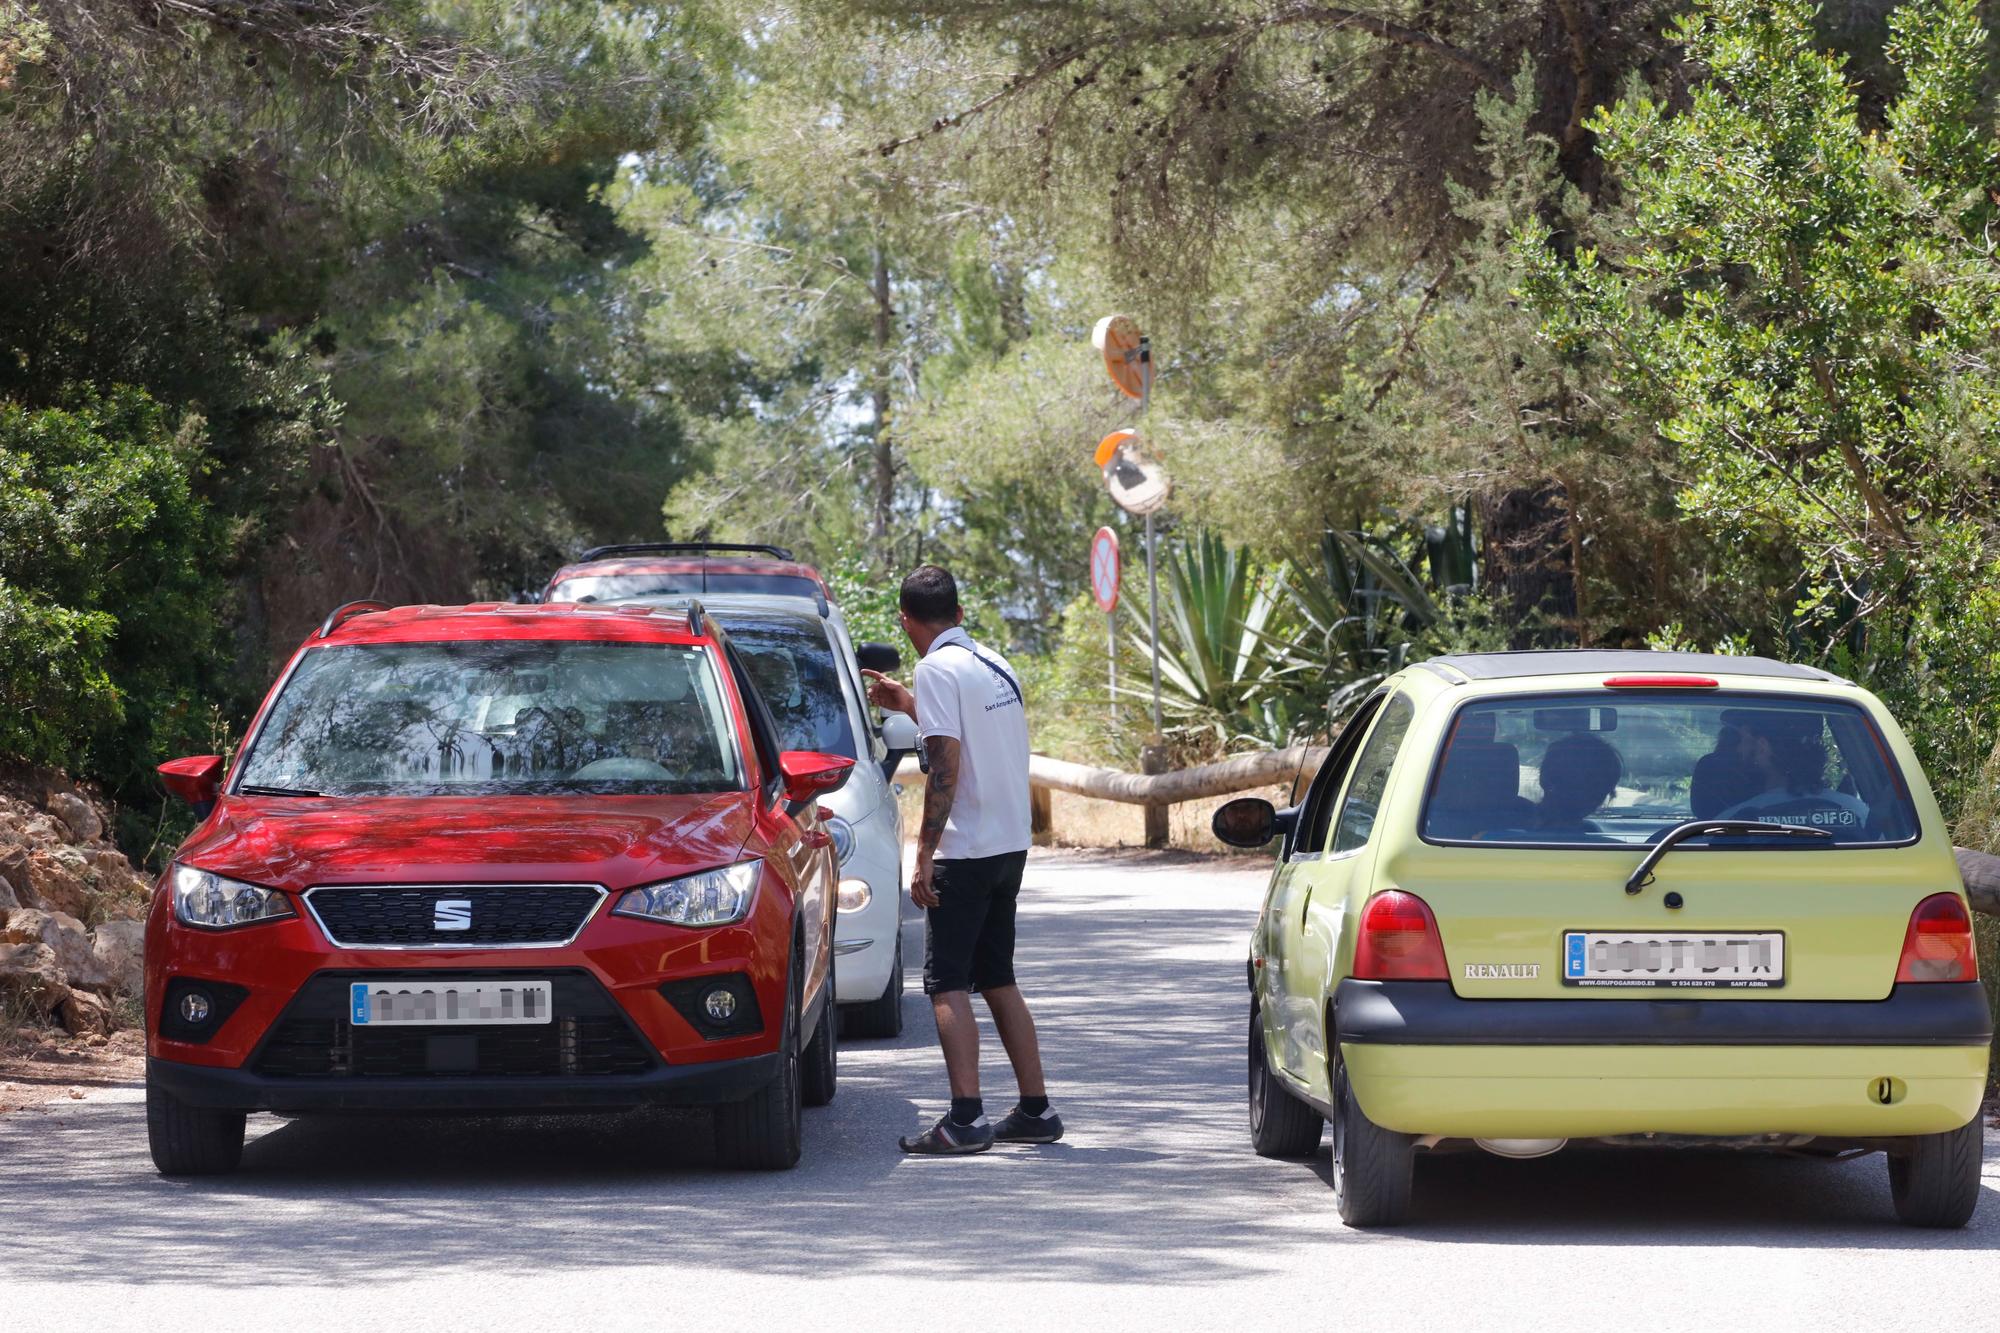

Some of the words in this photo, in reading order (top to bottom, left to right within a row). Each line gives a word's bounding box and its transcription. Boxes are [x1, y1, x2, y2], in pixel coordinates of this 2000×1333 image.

[1758, 815, 1807, 825] RENAULT
[1811, 811, 1837, 825] elf
[1572, 960, 1581, 970] E
[1464, 964, 1540, 979] RENAULT
[357, 1008, 364, 1017] E
